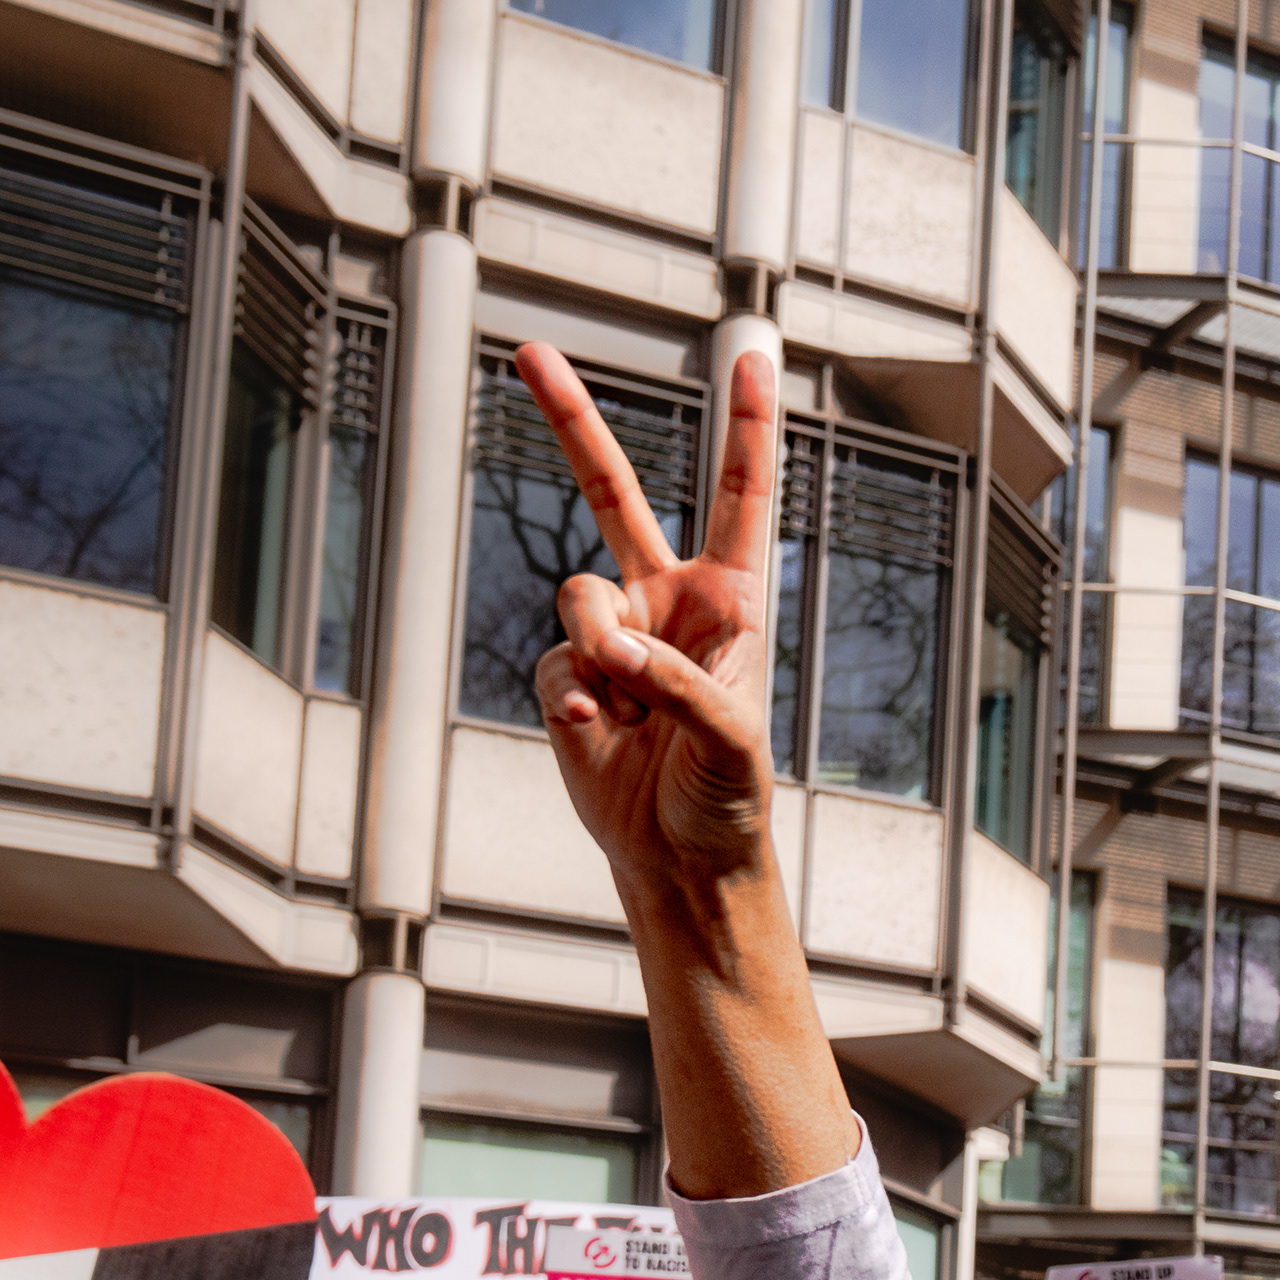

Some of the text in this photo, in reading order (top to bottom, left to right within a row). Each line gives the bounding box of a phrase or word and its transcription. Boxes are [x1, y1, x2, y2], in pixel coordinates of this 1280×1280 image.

[318, 1202, 578, 1275] WHO TH
[1156, 1265, 1174, 1280] UP
